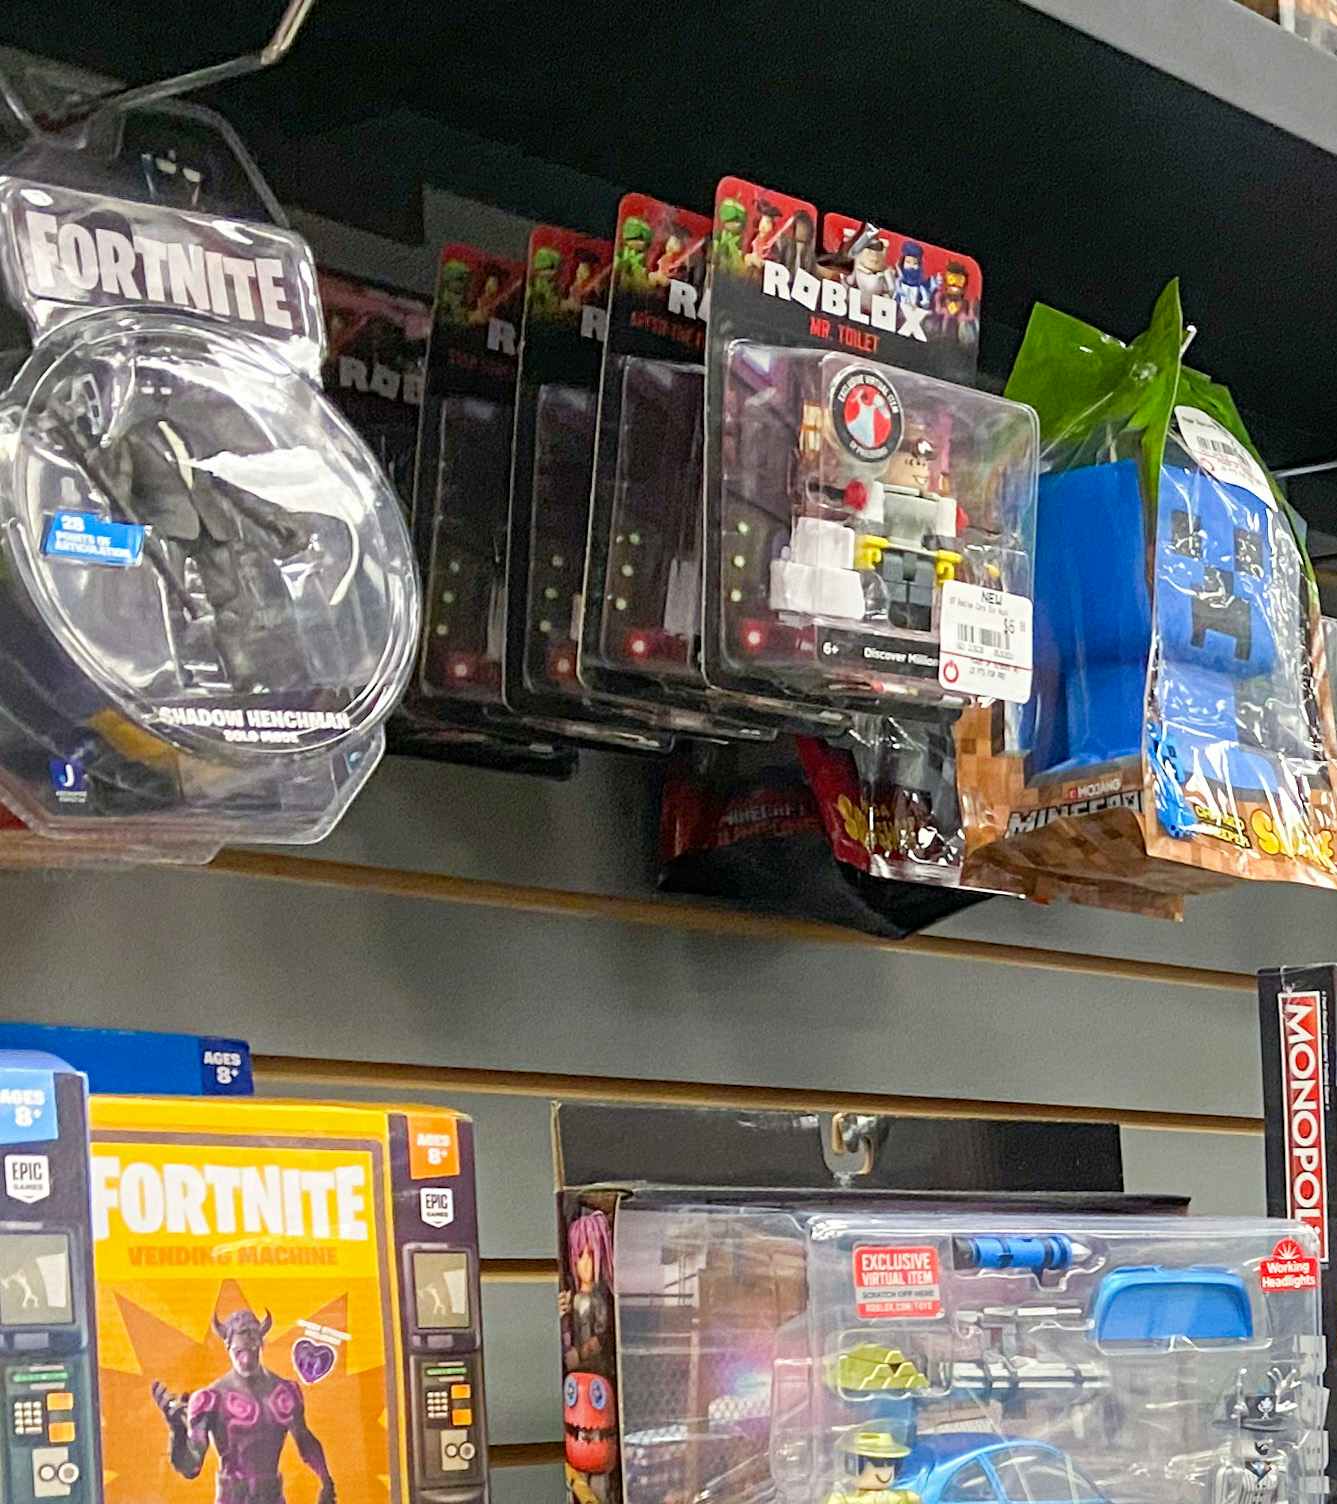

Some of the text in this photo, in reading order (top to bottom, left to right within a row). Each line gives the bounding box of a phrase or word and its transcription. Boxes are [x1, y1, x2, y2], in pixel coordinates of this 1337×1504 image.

[24, 210, 292, 330] FORTNITE
[762, 260, 928, 342] ROBLOX
[836, 323, 880, 353] TOILET
[981, 591, 1002, 605] NEW
[823, 642, 839, 657] 6+
[863, 647, 906, 664] Discover
[159, 706, 349, 729] SHADOW HENCHMAN
[203, 1050, 242, 1068] AGES
[11, 1159, 43, 1183] EPIC
[92, 1155, 366, 1242] FORTNITE
[425, 1191, 449, 1210] EPIC
[128, 1244, 337, 1268] VENDING MACHINE
[862, 1253, 930, 1271] EXCLUSIVE
[1266, 1258, 1310, 1276] Working
[862, 1270, 933, 1286] VIRTUAL ITEM
[1261, 1271, 1316, 1289] Headlights
